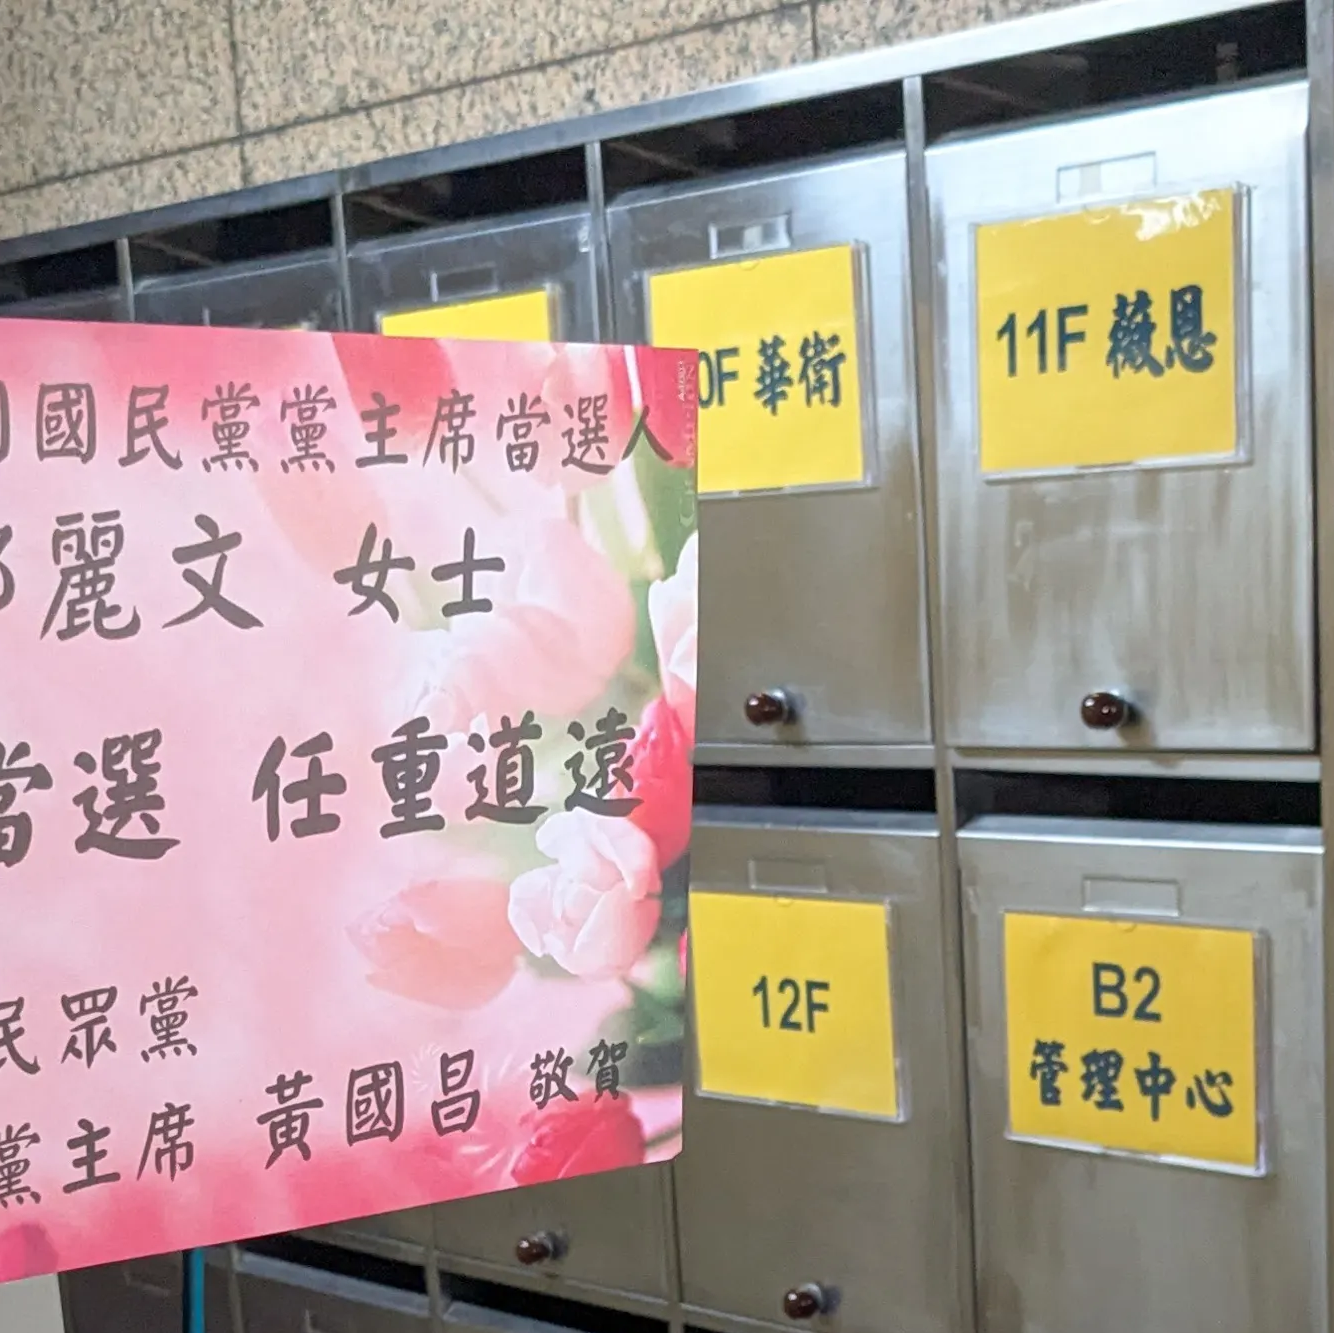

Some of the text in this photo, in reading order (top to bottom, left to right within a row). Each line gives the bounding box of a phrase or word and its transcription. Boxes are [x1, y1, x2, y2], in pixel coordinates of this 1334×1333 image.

[698, 346, 740, 409] 0F
[996, 304, 1088, 378] 11F
[333, 522, 506, 624] 女士
[251, 708, 643, 843] 任重道遠
[752, 975, 830, 1034] 12F
[1092, 962, 1162, 1023] B2
[256, 1048, 481, 1170] 黃國昌
[528, 1038, 630, 1111] 敬賀
[1029, 1039, 1235, 1122] 管理中心
